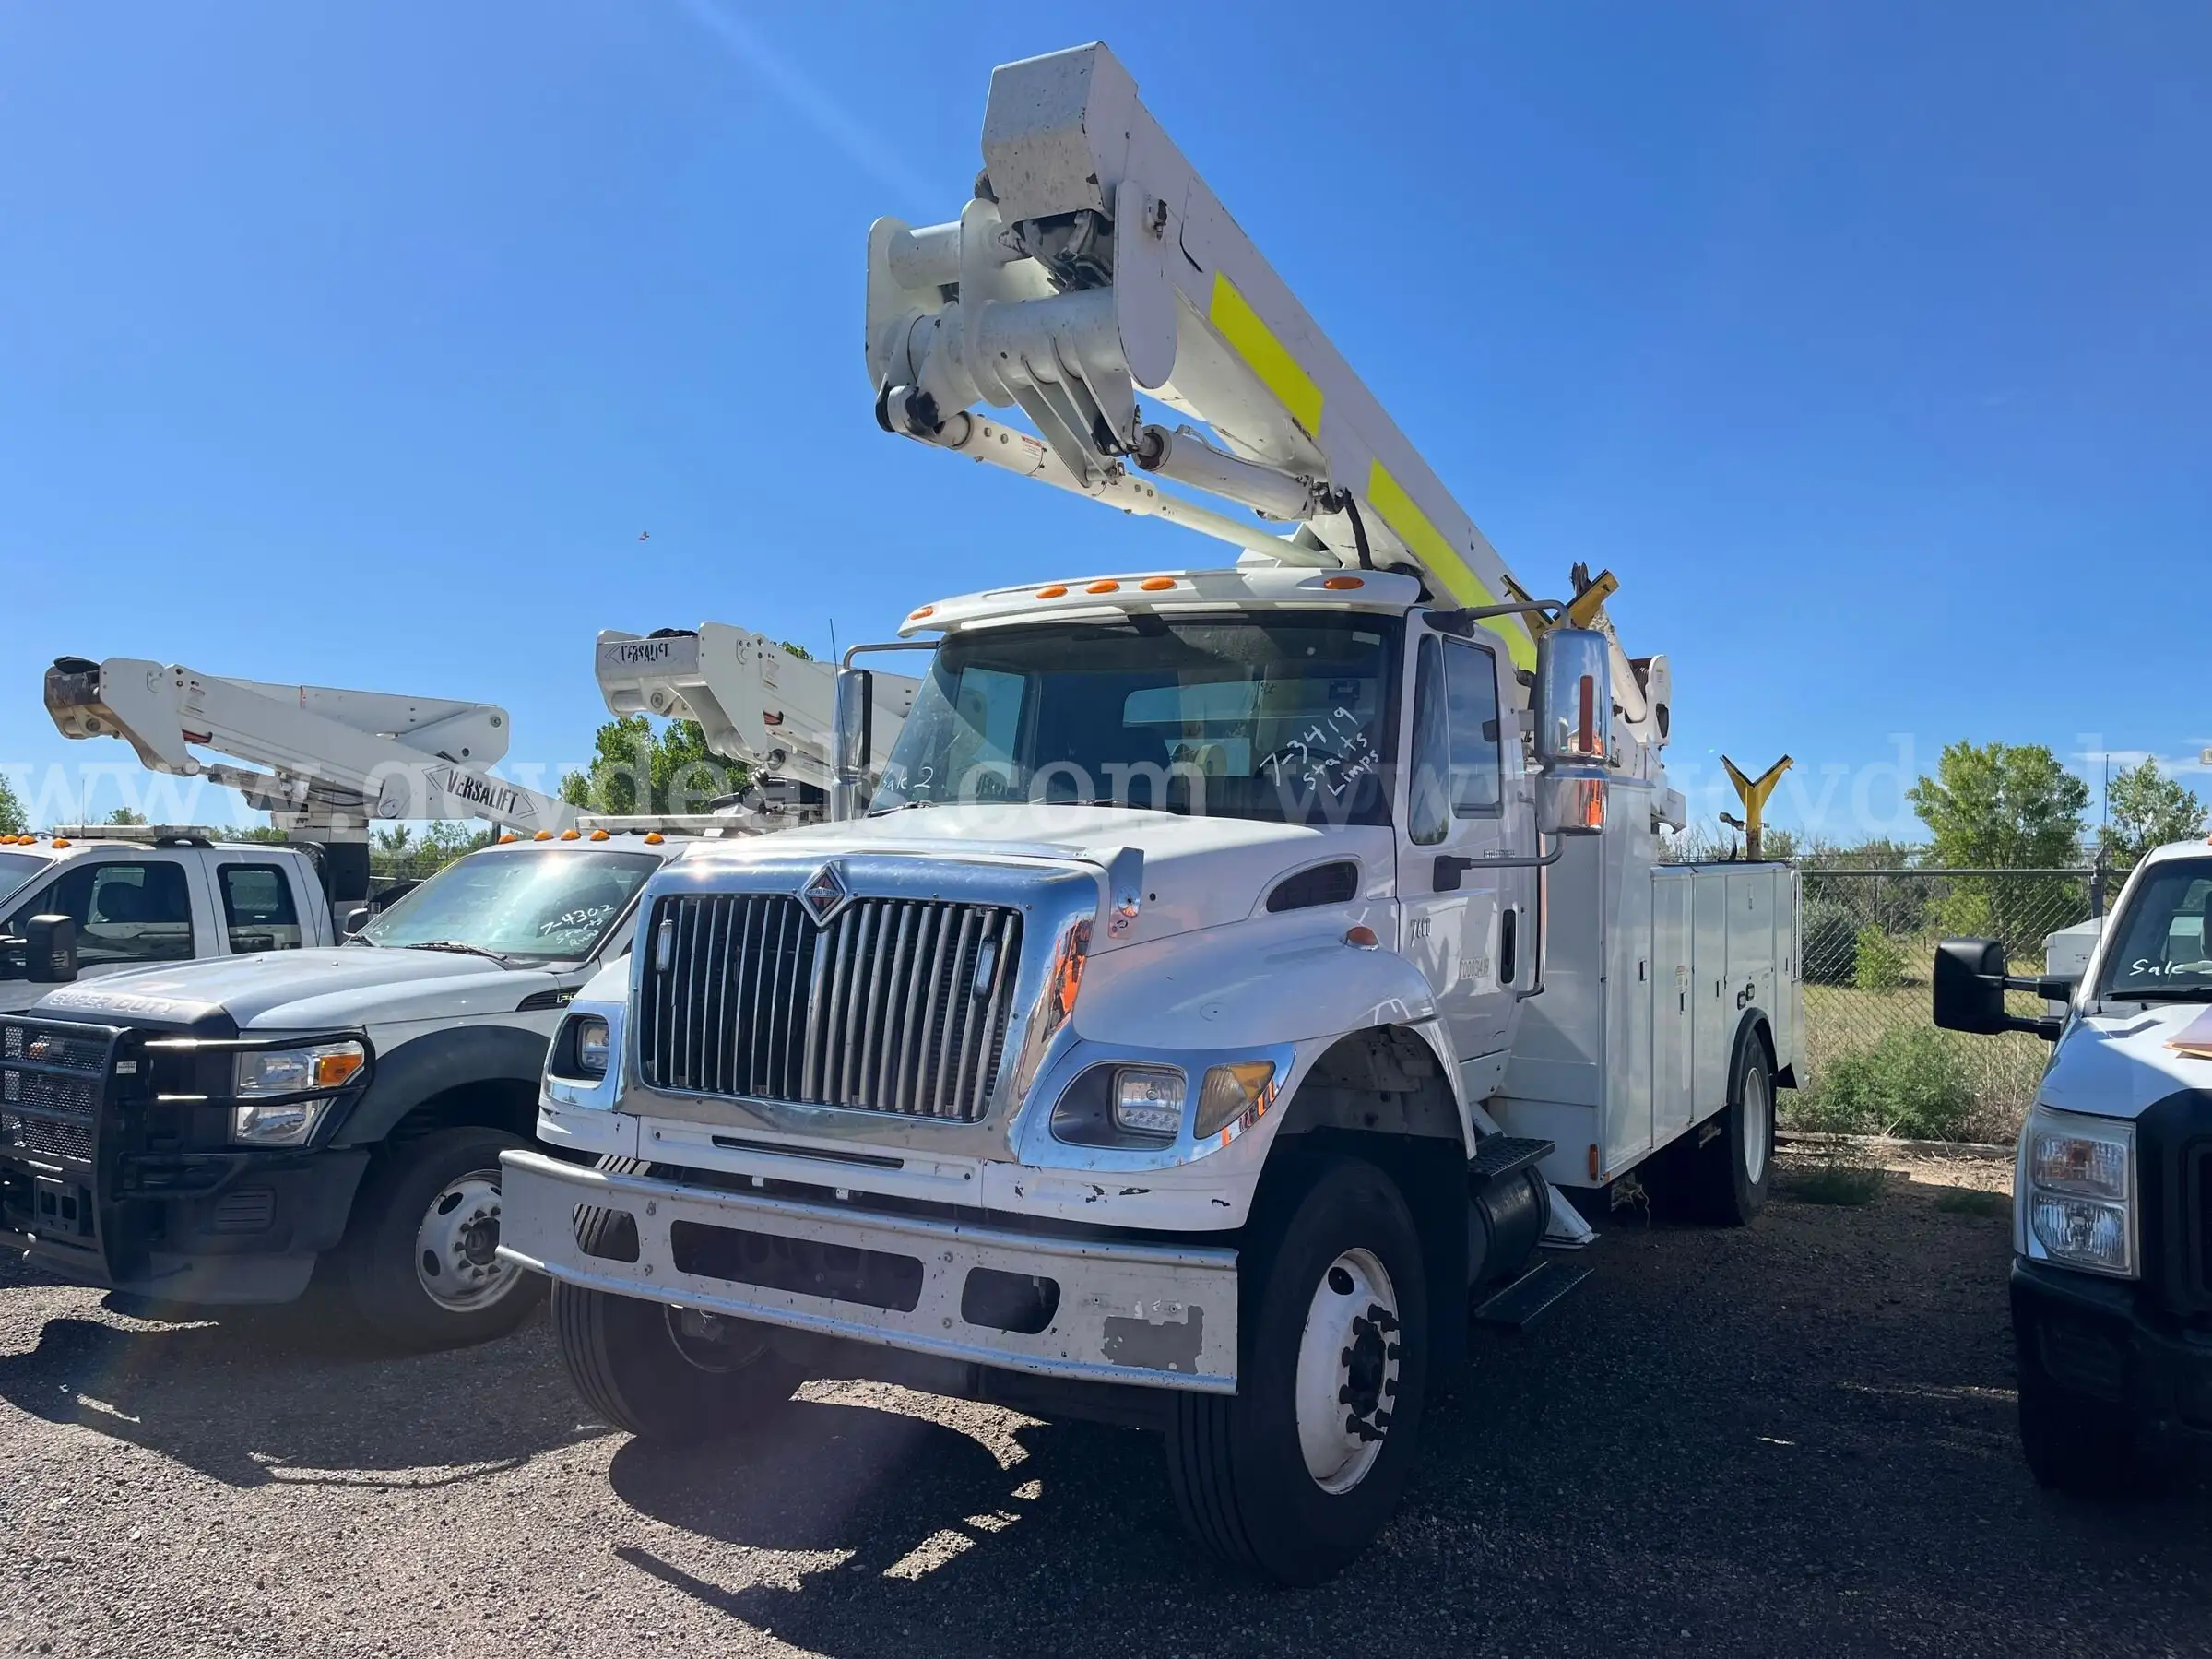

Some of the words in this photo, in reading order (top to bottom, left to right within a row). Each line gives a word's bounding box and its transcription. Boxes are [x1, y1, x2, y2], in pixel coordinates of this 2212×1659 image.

[913, 766, 933, 789] 2
[446, 769, 519, 814] VERSALIFT
[50, 992, 112, 1009] SUPER
[112, 997, 180, 1015] DUTY
